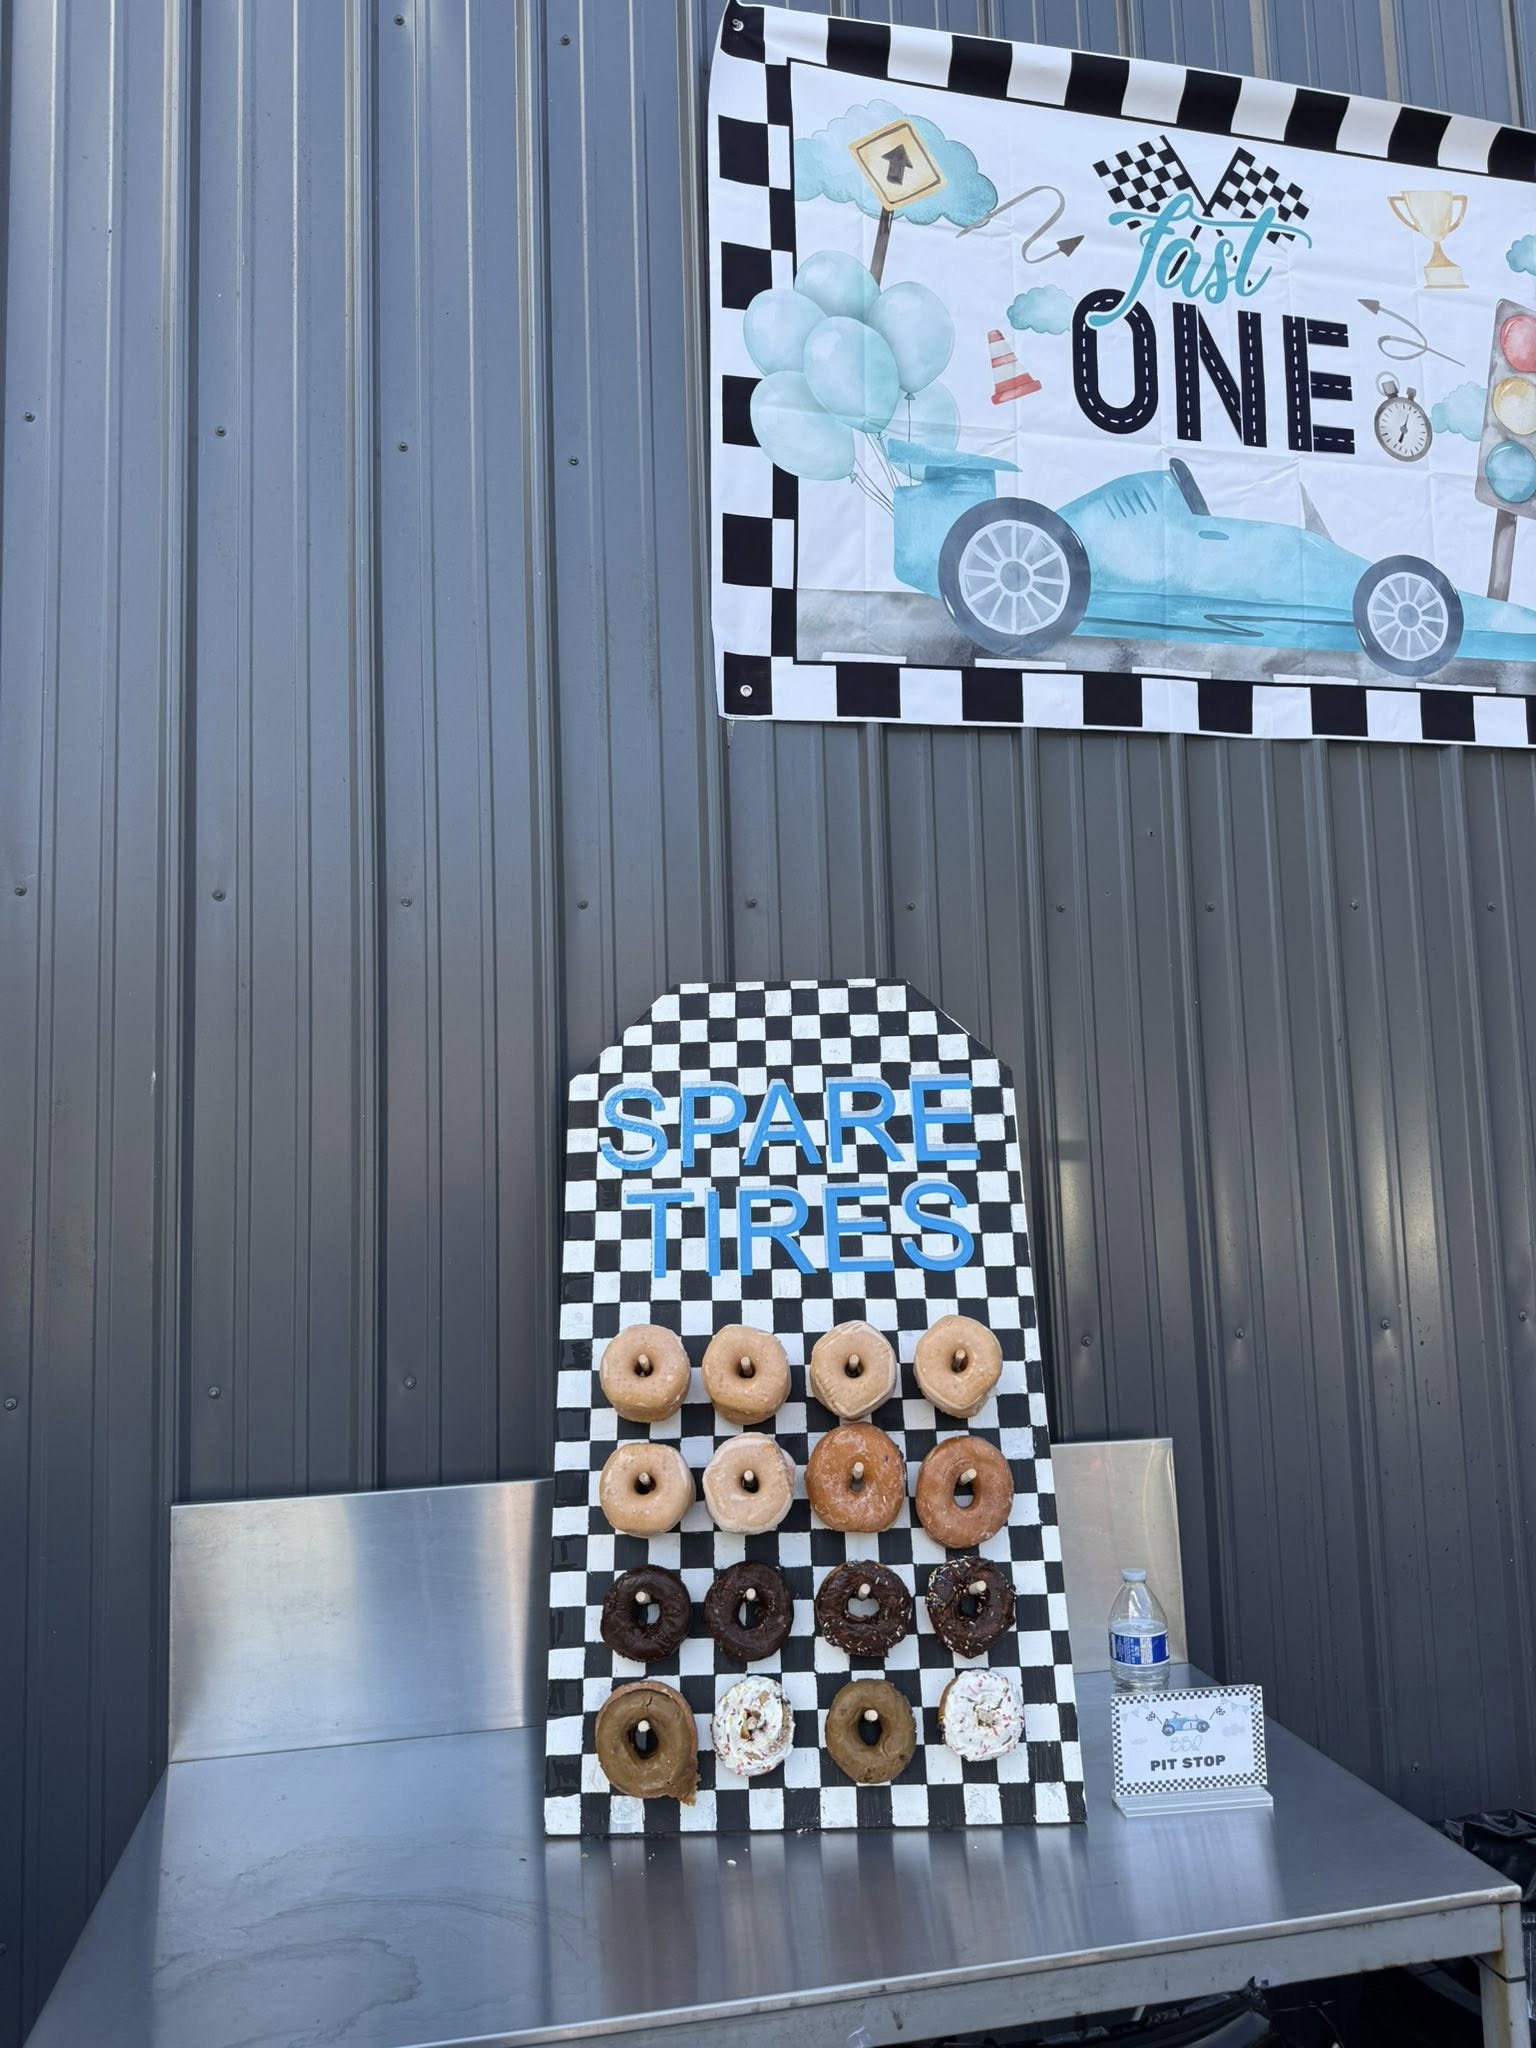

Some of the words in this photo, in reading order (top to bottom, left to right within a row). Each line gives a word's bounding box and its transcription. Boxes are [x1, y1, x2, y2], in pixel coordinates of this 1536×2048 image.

[1087, 192, 1312, 327] fast
[1072, 289, 1355, 455] ONE
[600, 1073, 981, 1171] SPARE
[625, 1178, 975, 1278] TIRES
[1150, 1758, 1177, 1772] PIT
[1182, 1755, 1226, 1769] STOP
